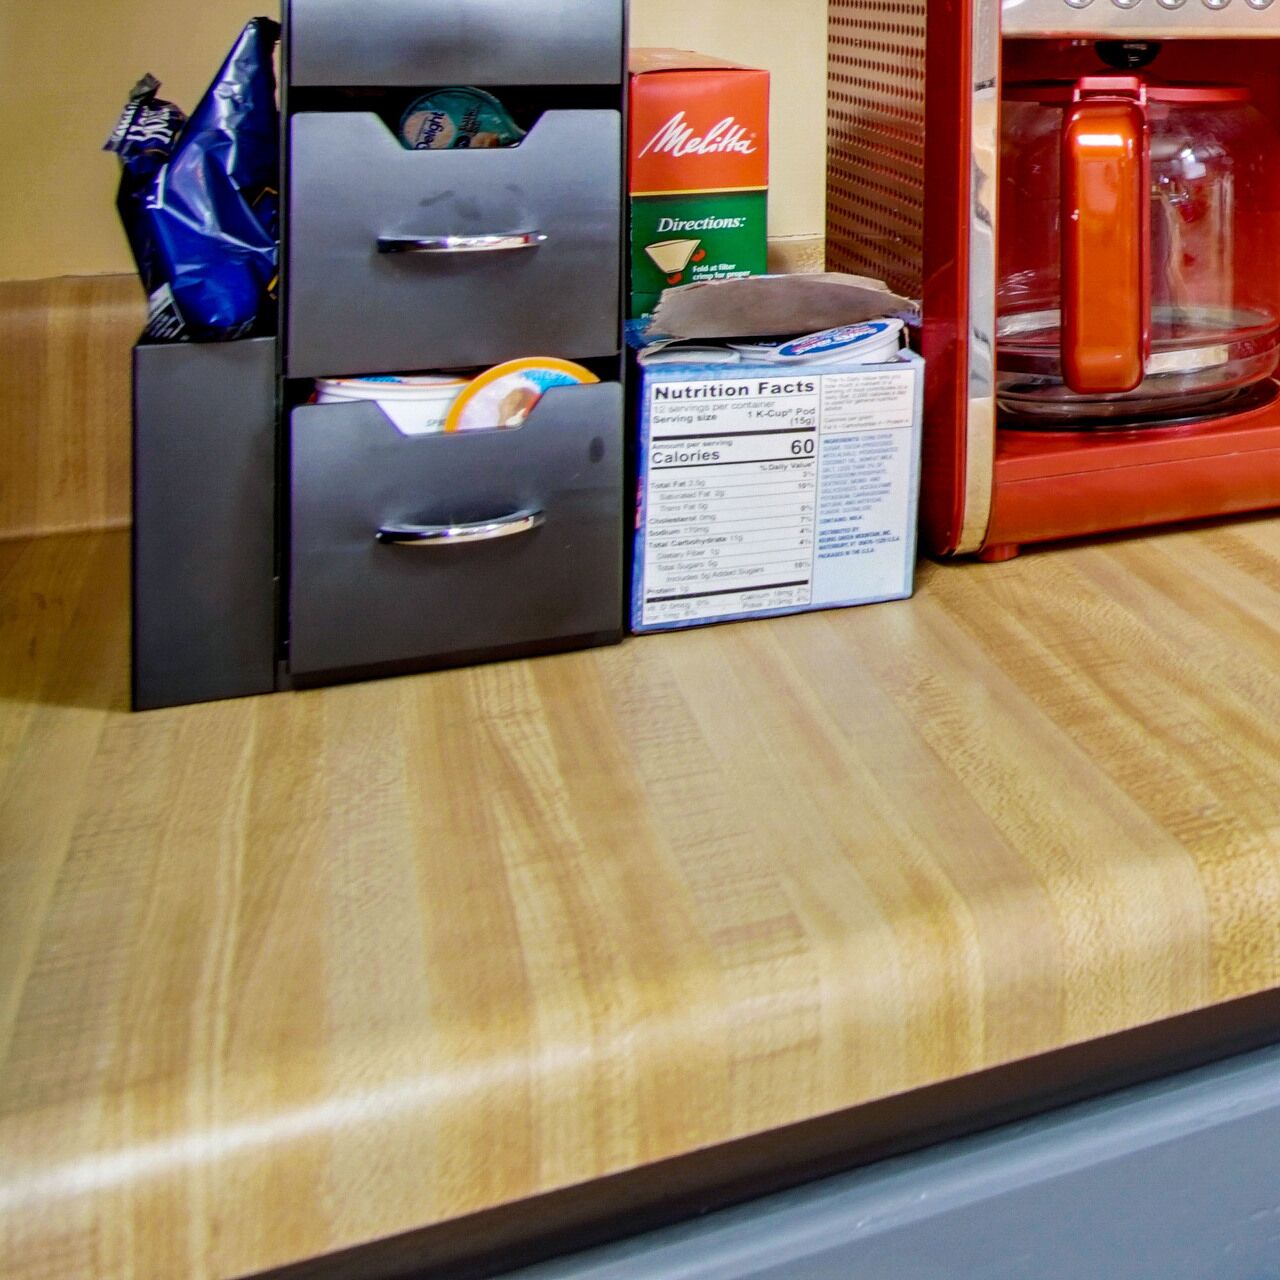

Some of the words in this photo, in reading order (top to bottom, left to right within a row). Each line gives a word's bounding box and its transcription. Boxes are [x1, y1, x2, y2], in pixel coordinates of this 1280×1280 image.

[415, 111, 446, 149] Delight
[638, 111, 757, 157] Melitta
[656, 216, 747, 232] Directions:
[655, 384, 749, 400] Nutrition
[758, 381, 814, 395] Facts
[668, 402, 710, 412] servings
[712, 402, 728, 410] per
[730, 400, 776, 409] container
[796, 407, 815, 415] Pod
[653, 414, 693, 424] Serving
[790, 416, 815, 426] (15g)
[791, 438, 814, 455] 60
[652, 450, 720, 464] Calories
[768, 463, 788, 471] Daily
